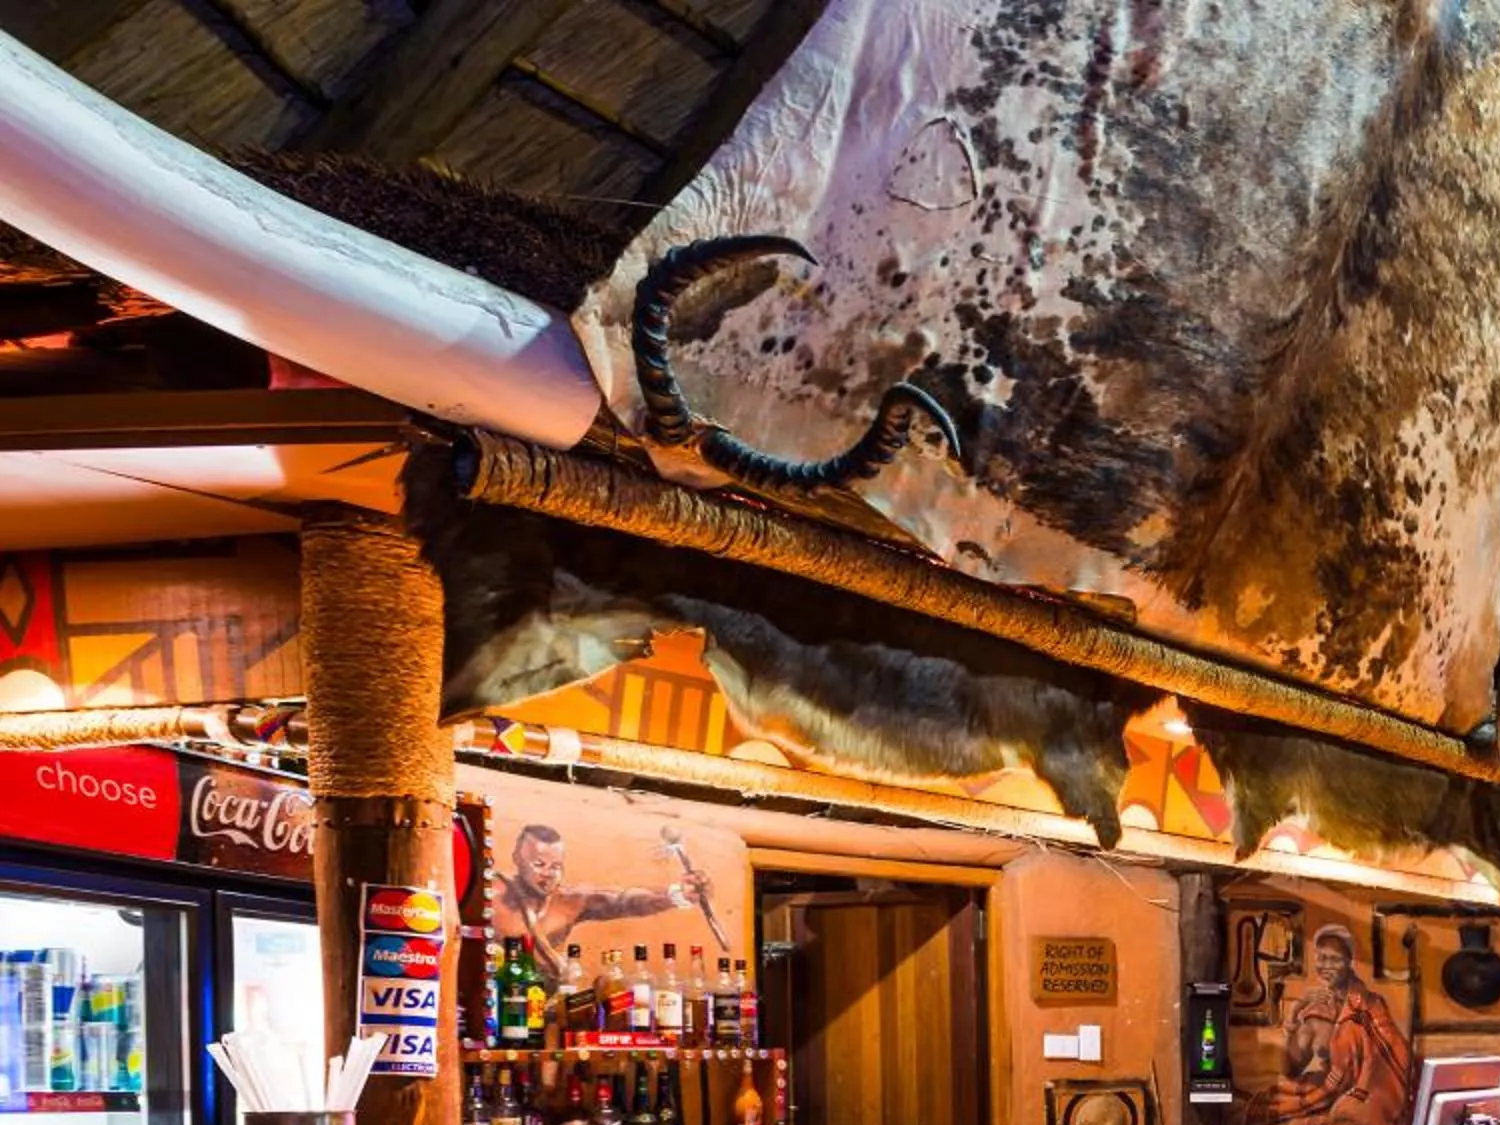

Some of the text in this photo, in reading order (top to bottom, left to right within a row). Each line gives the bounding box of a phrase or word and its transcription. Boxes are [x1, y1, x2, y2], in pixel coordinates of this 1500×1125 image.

[35, 760, 157, 809] choose
[190, 774, 316, 855] Coca-Col
[373, 949, 437, 965] Maestro
[1045, 943, 1104, 960] RIGHT OF
[1040, 962, 1110, 977] ADMISSION
[1043, 978, 1109, 994] RESERVED
[372, 986, 435, 1009] VISA
